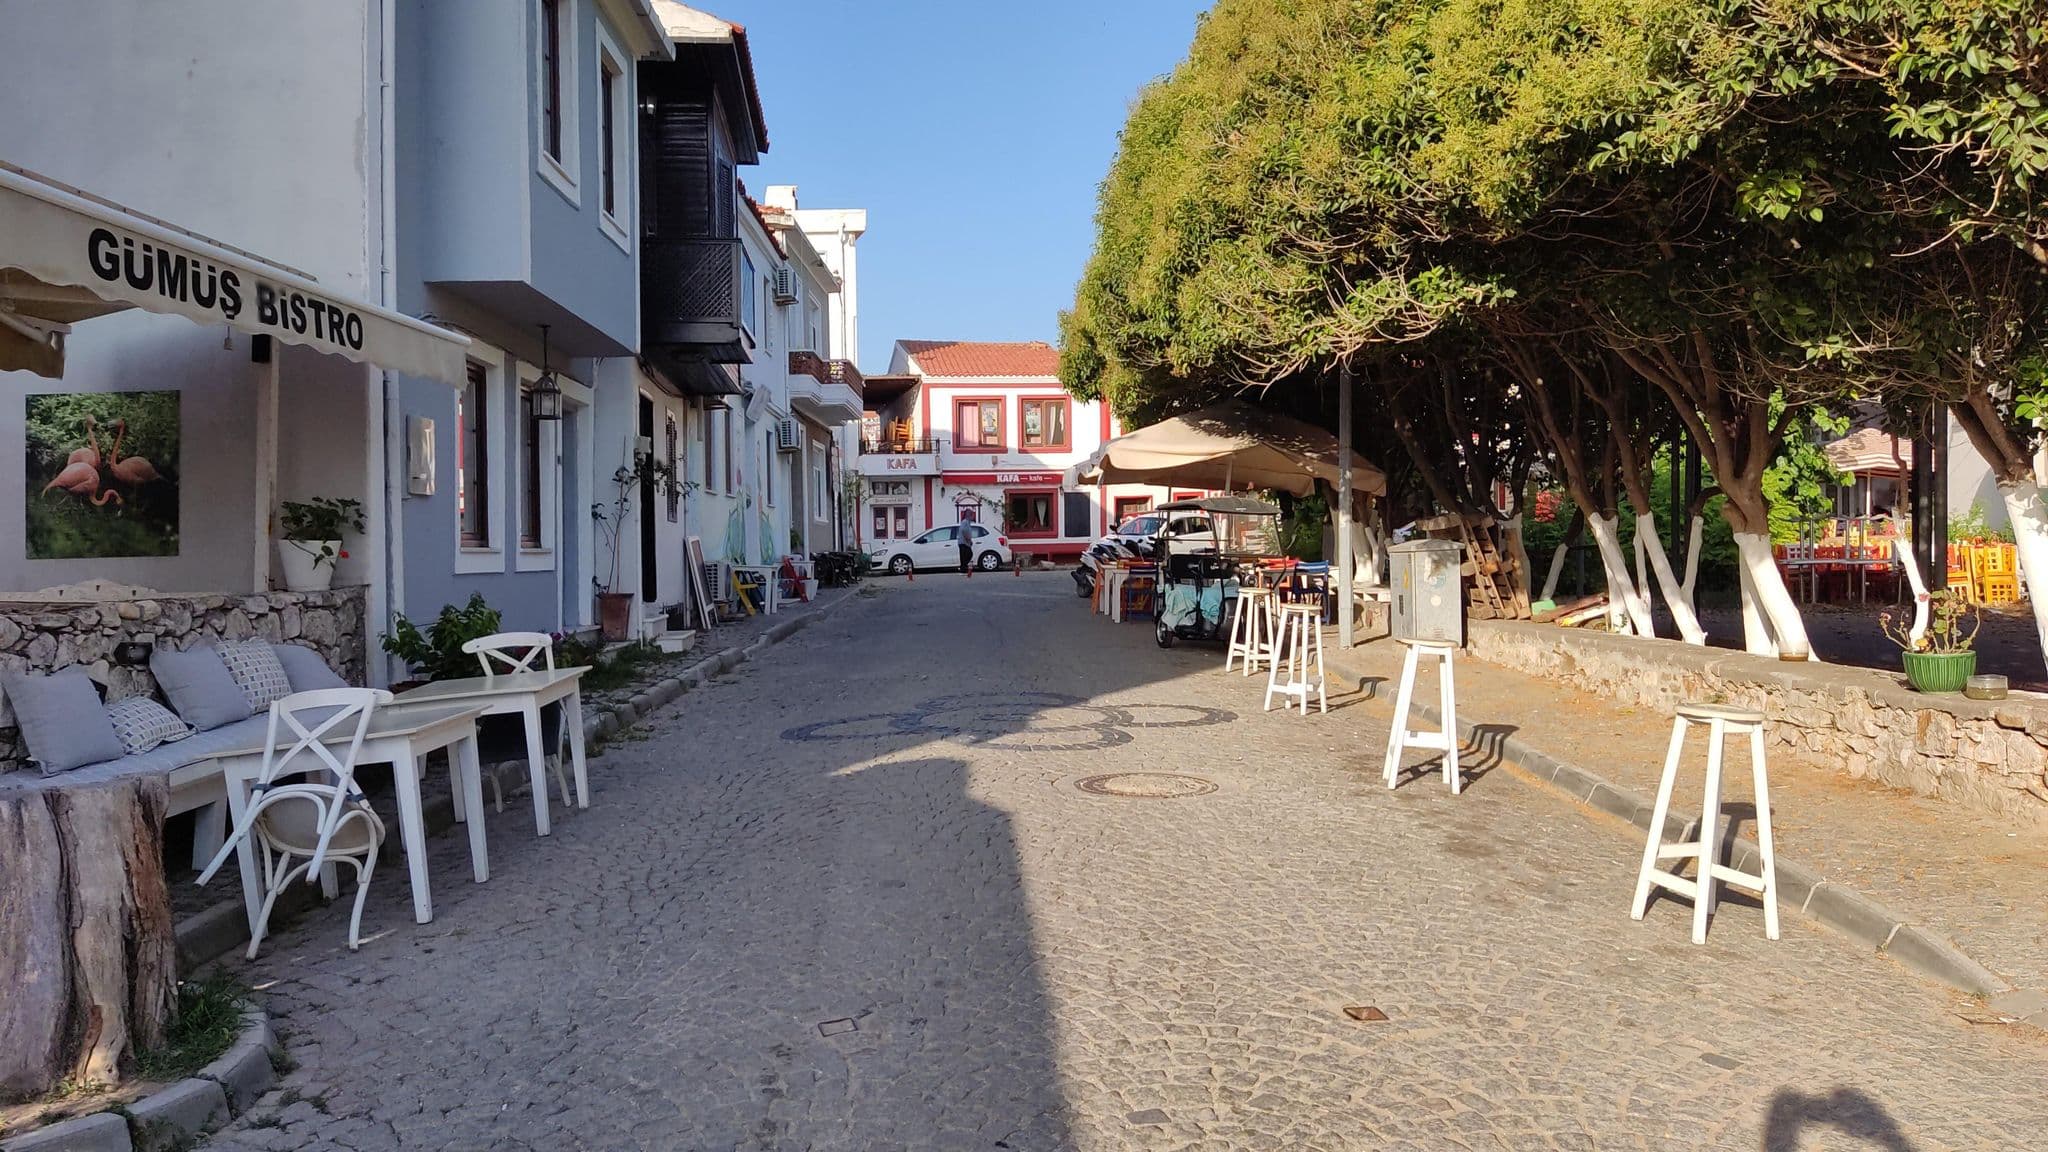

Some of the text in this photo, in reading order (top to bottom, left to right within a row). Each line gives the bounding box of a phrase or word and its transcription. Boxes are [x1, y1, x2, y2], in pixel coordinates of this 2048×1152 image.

[88, 228, 242, 320] GÜMÜŞ
[886, 458, 917, 469] KAFA
[996, 472, 1020, 483] KAFA
